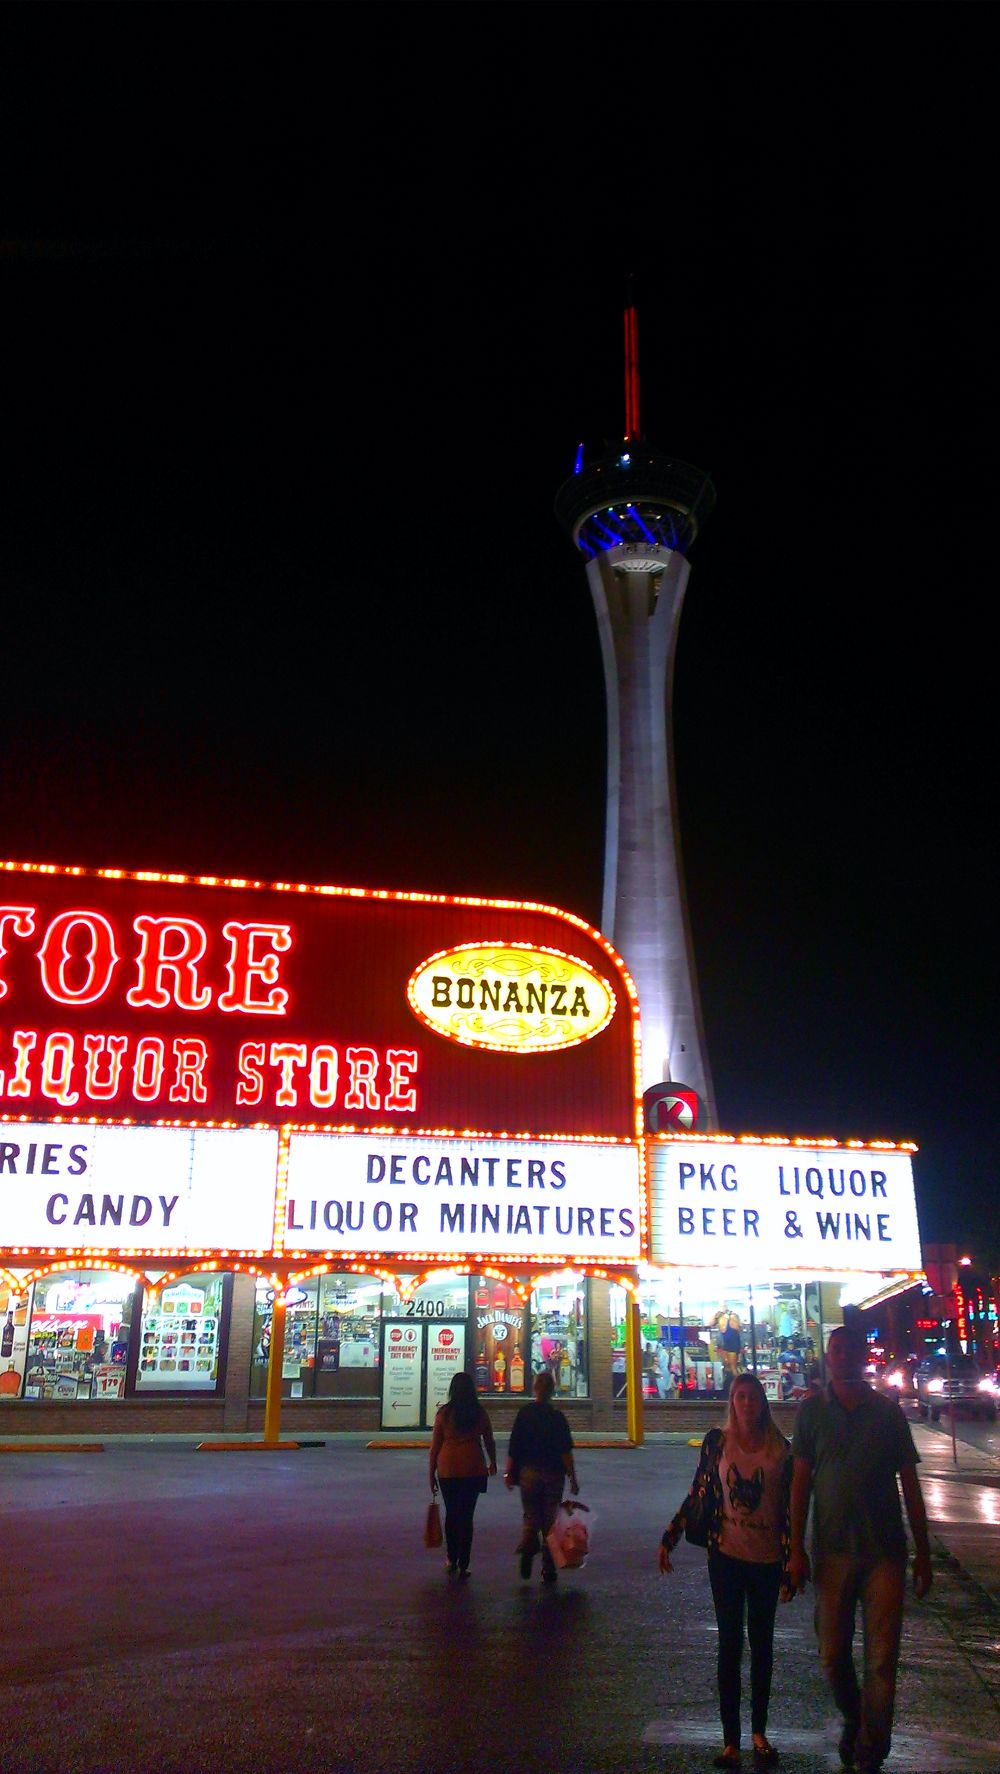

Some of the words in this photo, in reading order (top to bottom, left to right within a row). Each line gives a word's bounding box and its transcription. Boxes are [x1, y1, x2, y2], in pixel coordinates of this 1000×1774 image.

[431, 975, 591, 1018] BONANZA
[0, 1030, 208, 1106] IQUOR
[235, 1042, 419, 1112] STORE
[657, 1101, 691, 1131] K
[0, 1142, 89, 1175] RIES
[366, 1154, 567, 1190] DECANTERS
[678, 1162, 738, 1192] PKG
[778, 1166, 888, 1200] LIQUOR
[46, 1193, 180, 1227] CANDY
[287, 1199, 419, 1235] LIQUOR
[440, 1203, 636, 1238] MINIATURES
[678, 1207, 760, 1238] BEER
[783, 1210, 804, 1239] &
[816, 1211, 893, 1242] WINE
[406, 1300, 445, 1317] 2400
